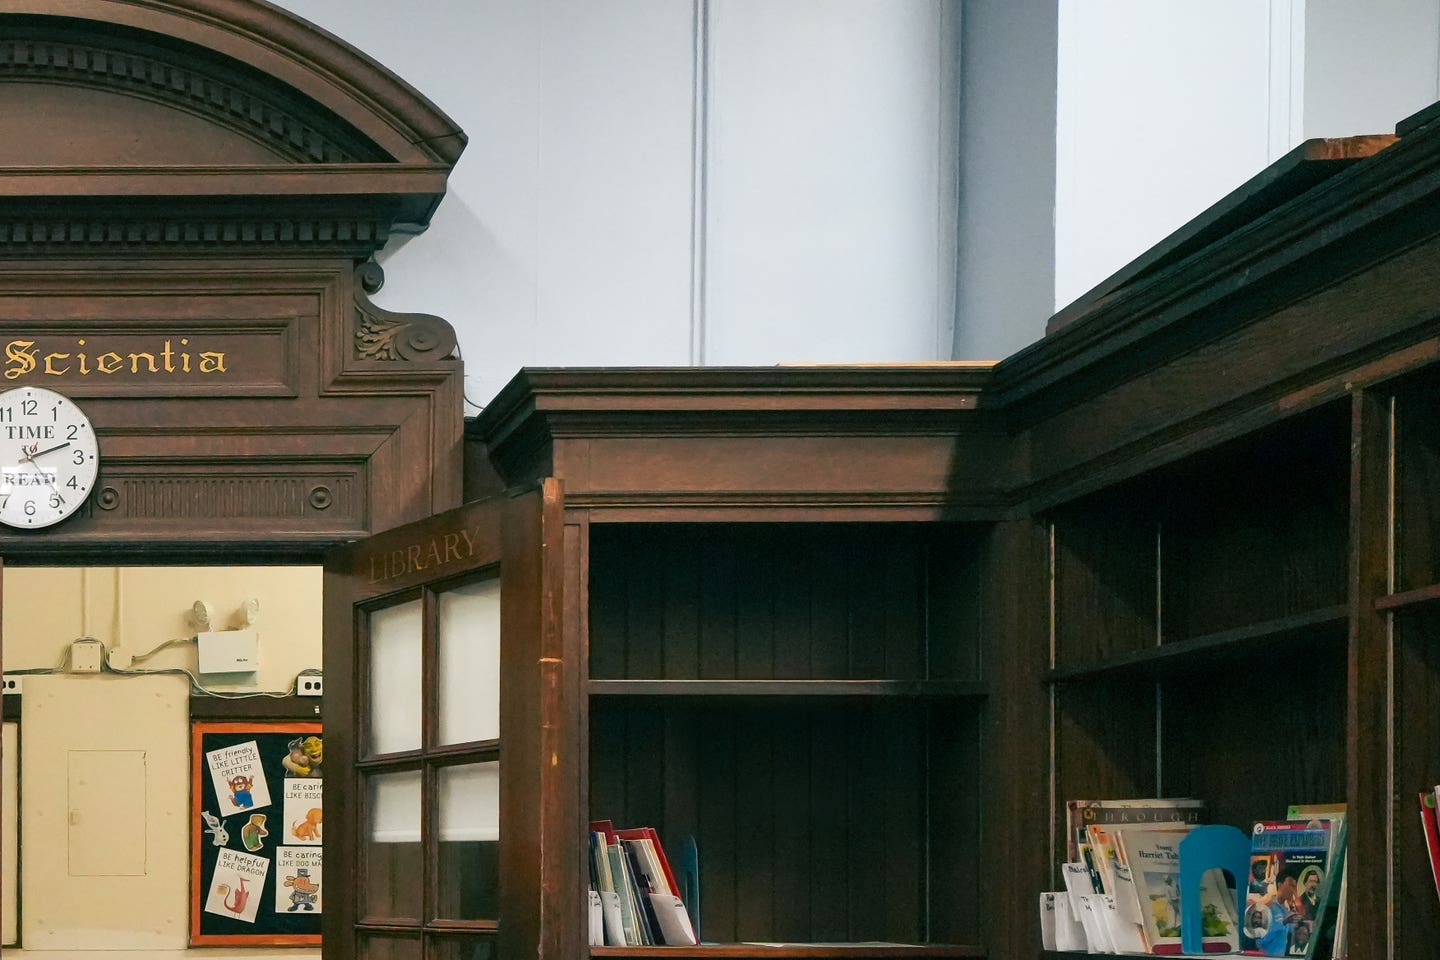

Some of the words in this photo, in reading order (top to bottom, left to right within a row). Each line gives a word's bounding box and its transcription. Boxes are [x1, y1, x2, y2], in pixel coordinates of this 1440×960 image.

[4, 338, 227, 380] Scientia
[21, 399, 38, 416] 12
[50, 406, 57, 422] 1
[5, 425, 55, 440] TIME
[66, 424, 78, 441] 2
[72, 450, 84, 466] 3
[2, 472, 56, 488] READ
[65, 474, 79, 490] 4
[0, 493, 11, 510] 7
[23, 499, 37, 516] 6
[48, 493, 61, 509] 5
[368, 525, 481, 586] LIBRARY
[212, 753, 223, 762] BE
[224, 747, 254, 760] friendly
[212, 760, 230, 771] LIKE
[230, 753, 257, 767] LITTLE
[221, 764, 253, 777] CRITTER
[292, 783, 302, 791] BE
[223, 852, 233, 861] BE
[234, 852, 265, 868] helpful
[1139, 850, 1164, 859] Harriet
[218, 861, 236, 871] LIKE
[236, 864, 265, 877] DRAGON
